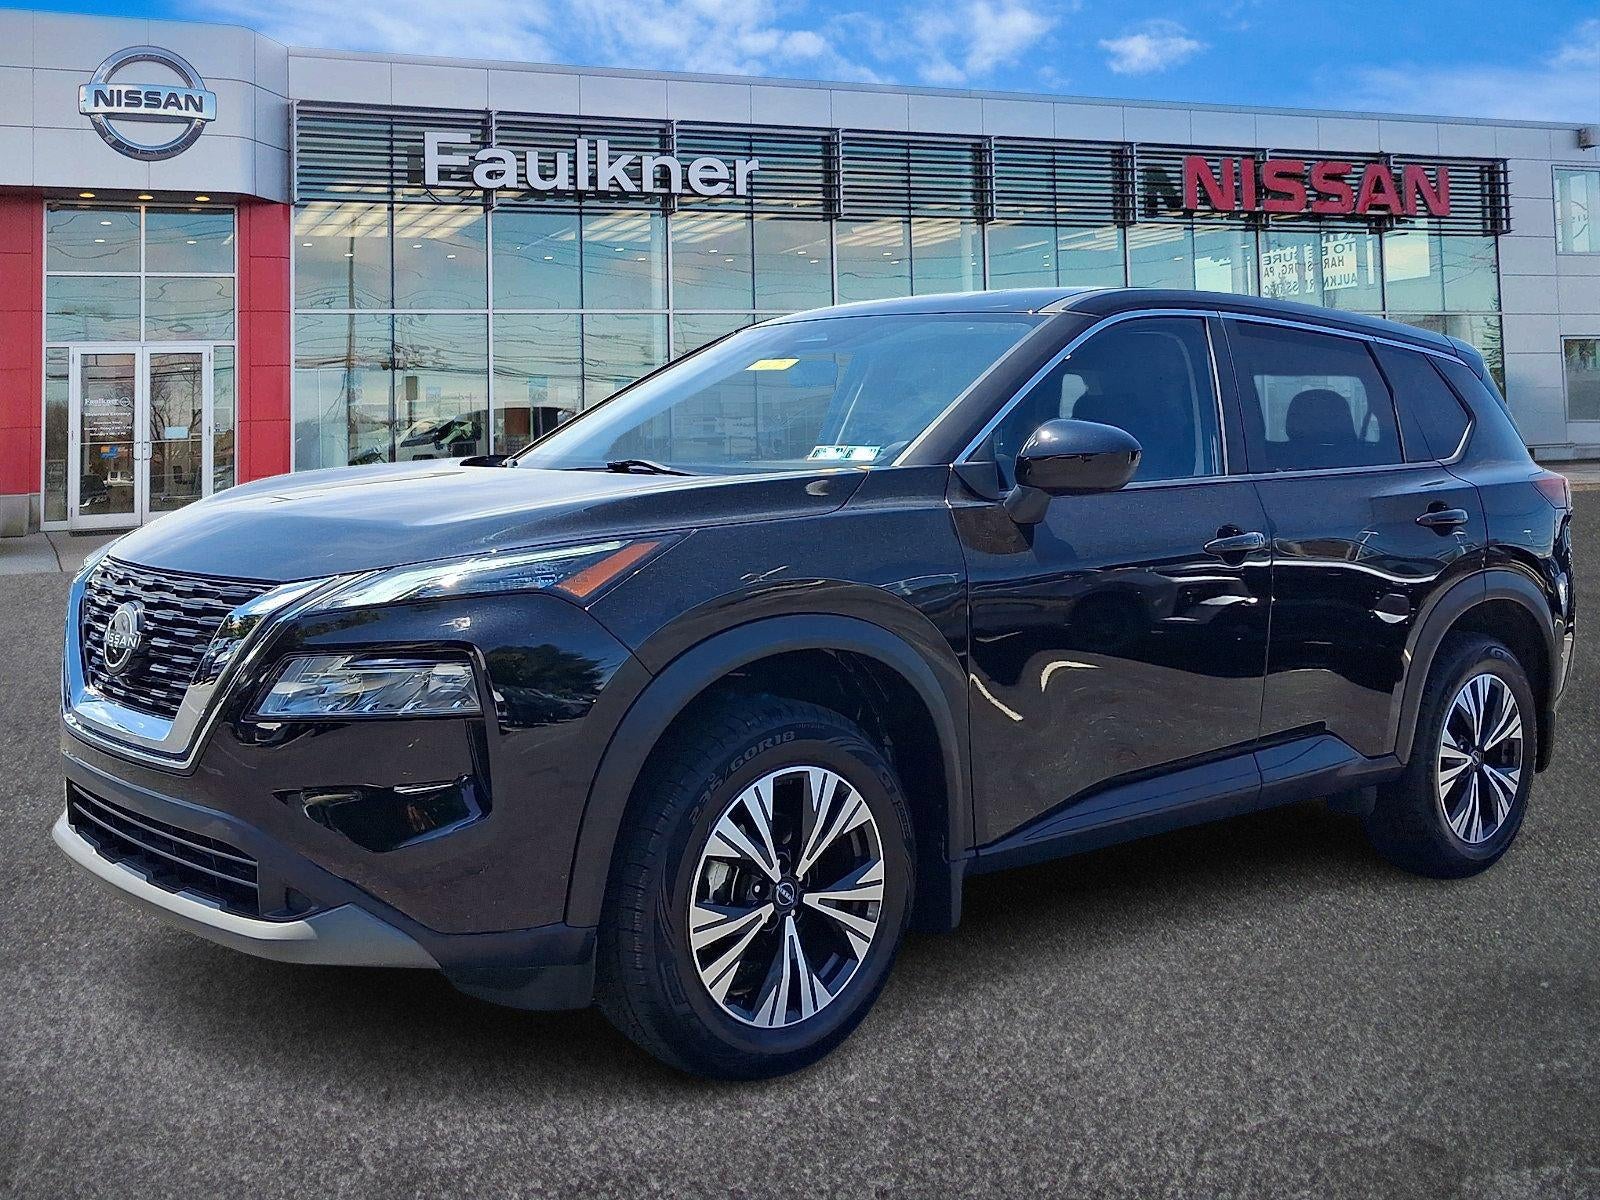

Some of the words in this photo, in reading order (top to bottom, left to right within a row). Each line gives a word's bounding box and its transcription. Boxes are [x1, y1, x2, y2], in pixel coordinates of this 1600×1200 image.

[94, 89, 203, 113] NISSAN
[424, 131, 759, 196] Faulkner
[1182, 155, 1451, 216] NISSAN
